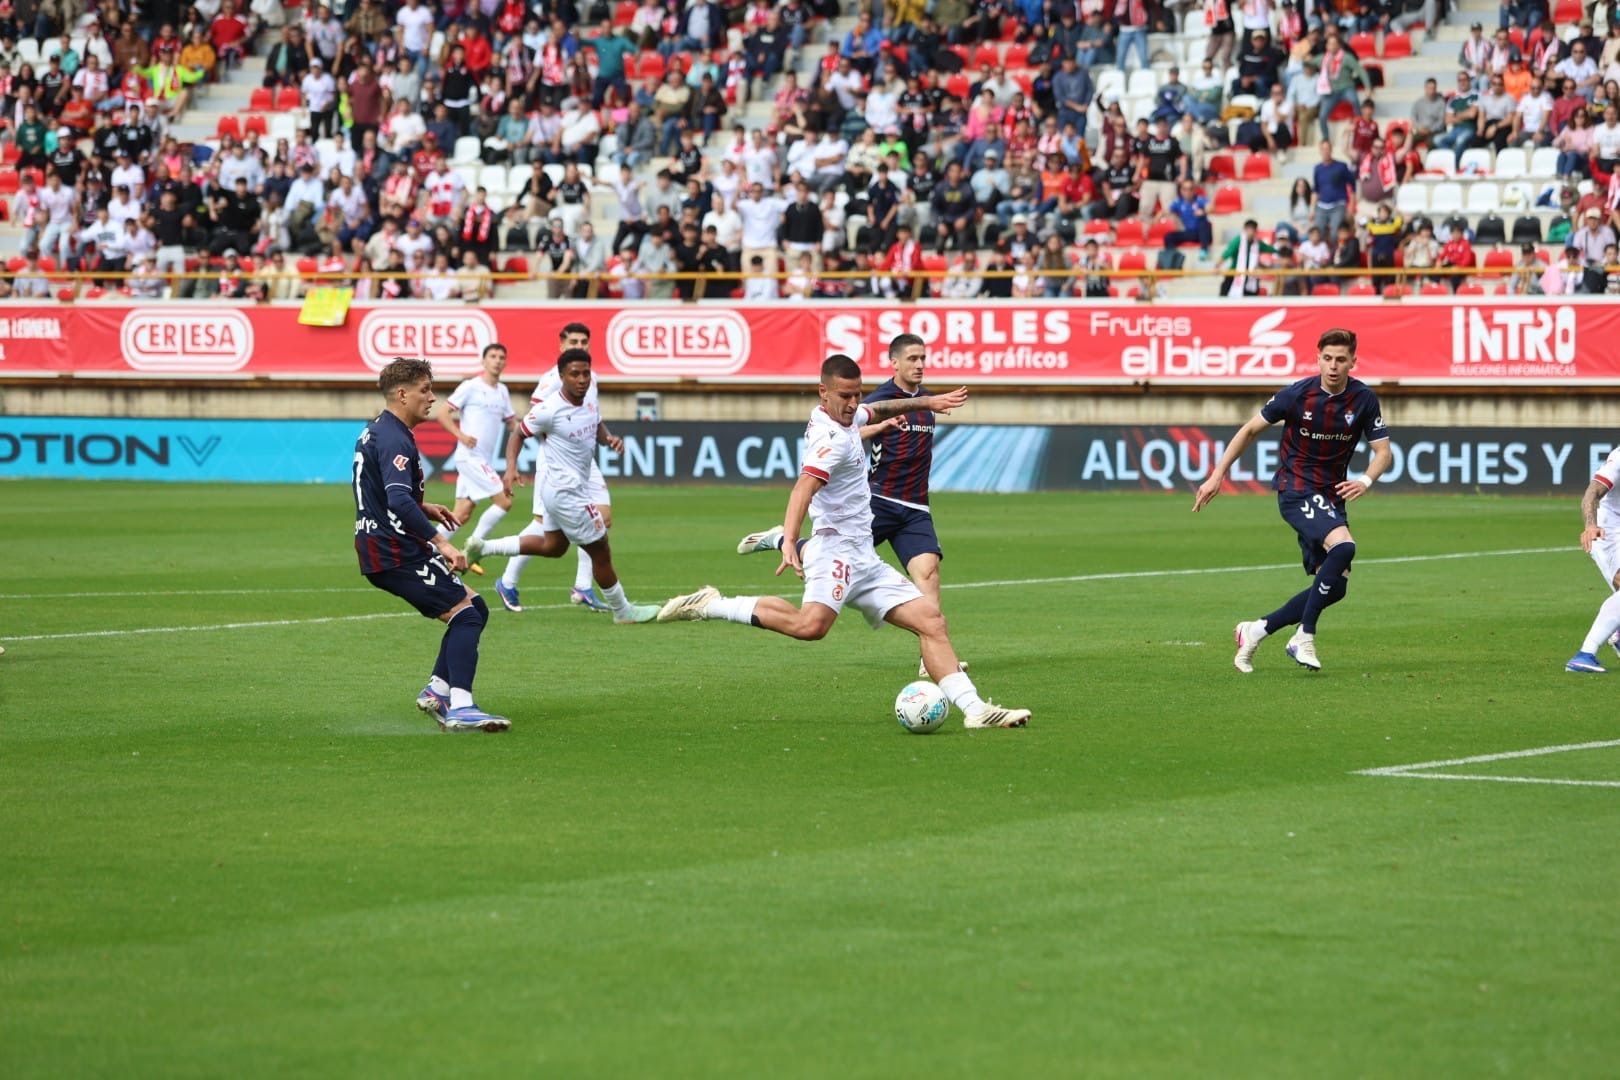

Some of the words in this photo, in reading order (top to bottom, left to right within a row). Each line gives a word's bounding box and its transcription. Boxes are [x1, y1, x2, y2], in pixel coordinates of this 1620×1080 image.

[133, 324, 237, 356] CERLESA
[372, 324, 480, 357] CERLESA
[878, 310, 1072, 345] SORLES
[1090, 311, 1192, 337] Frutas
[1452, 305, 1577, 365] INTRO
[621, 325, 732, 358] CERLESA
[1121, 337, 1158, 376] el
[1164, 336, 1297, 376] bierzo
[879, 347, 976, 369] sicios
[979, 346, 1069, 373] gráficos
[600, 436, 683, 477] ENT
[692, 436, 726, 478] A
[736, 436, 806, 479] CA
[1542, 442, 1574, 485] Y
